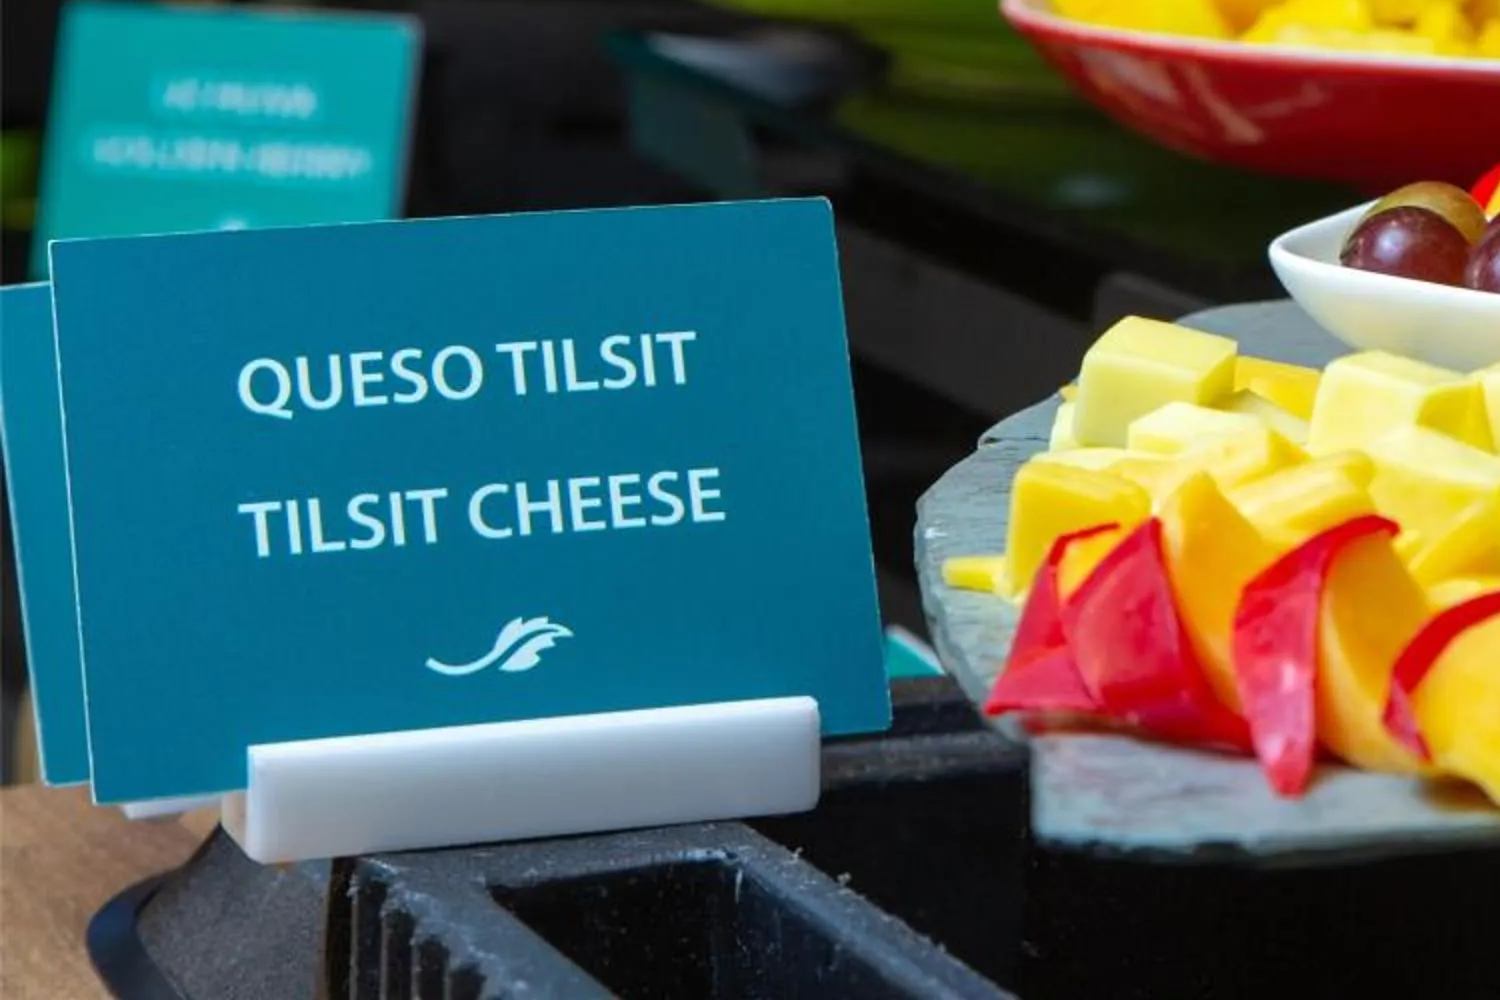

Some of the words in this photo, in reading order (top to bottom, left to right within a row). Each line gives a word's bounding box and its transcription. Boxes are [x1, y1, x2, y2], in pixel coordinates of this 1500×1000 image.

[237, 344, 484, 420] QUESO
[495, 331, 697, 395] TILSIT
[237, 487, 449, 557] TILSIT
[468, 467, 726, 539] CHEESE
